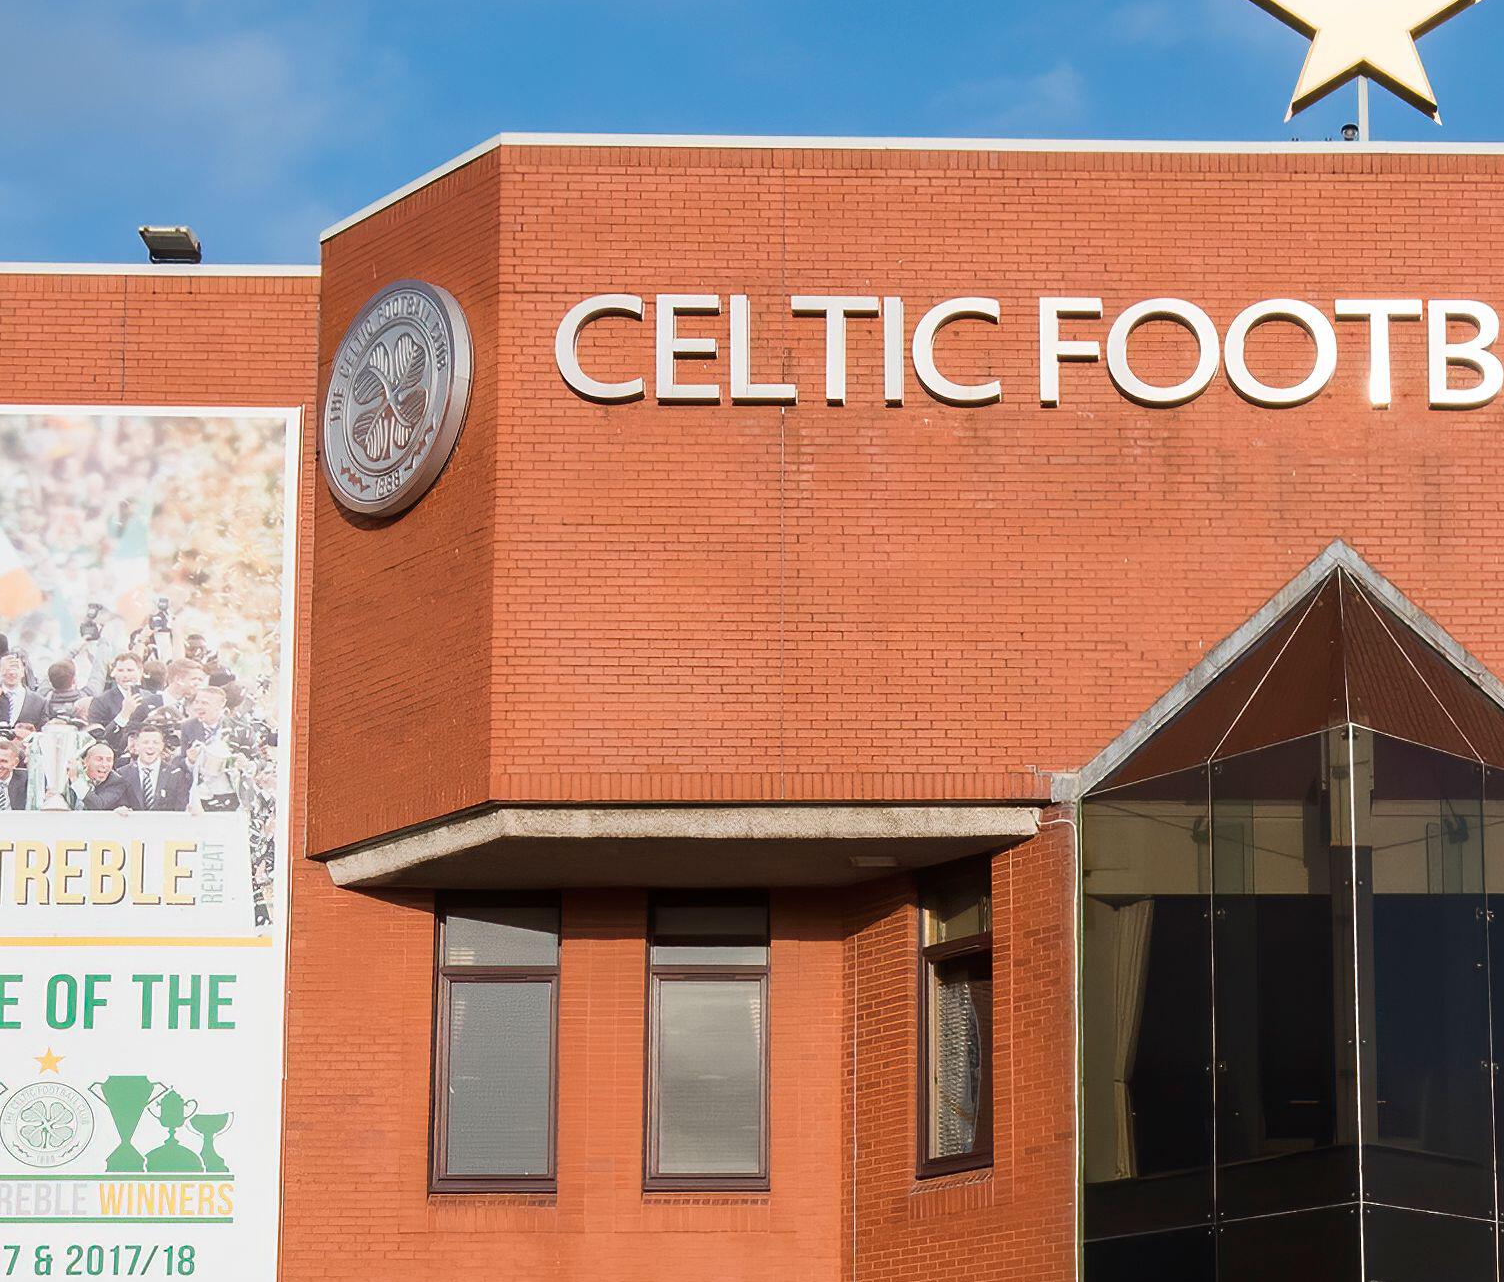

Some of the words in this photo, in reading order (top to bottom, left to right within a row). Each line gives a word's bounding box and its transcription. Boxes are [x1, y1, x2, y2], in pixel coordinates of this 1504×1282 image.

[554, 293, 1001, 407] CELTIC
[375, 471, 402, 497] 1888
[200, 839, 226, 904] REPEAT
[45, 973, 112, 1029] OF
[132, 973, 238, 1029] THE
[99, 1182, 234, 1216] WINNERS
[34, 1245, 53, 1276] &
[66, 1245, 197, 1277] 2017/18
